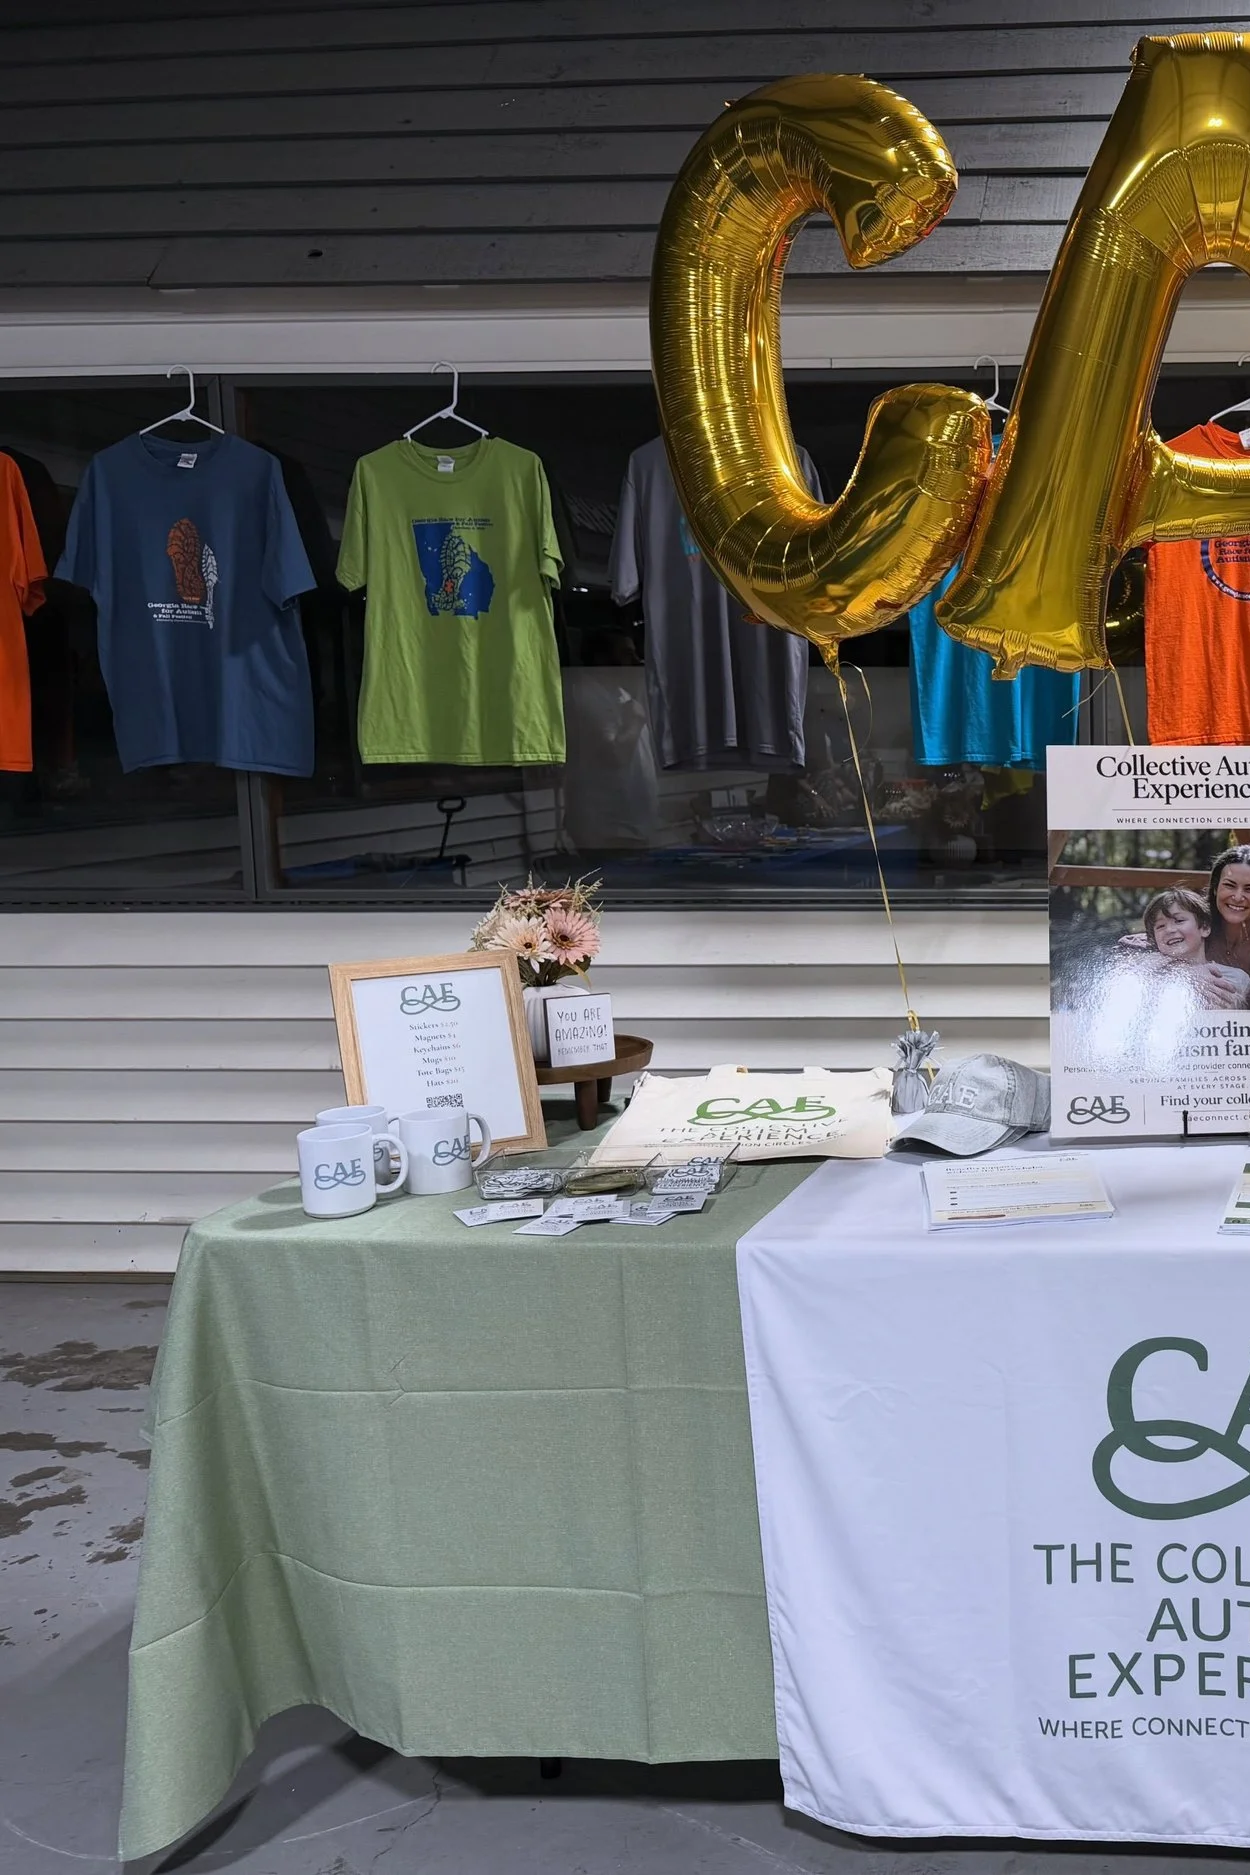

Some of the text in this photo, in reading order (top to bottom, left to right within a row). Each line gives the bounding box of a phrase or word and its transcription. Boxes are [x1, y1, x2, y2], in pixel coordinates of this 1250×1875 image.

[1096, 754, 1211, 778] Collective
[401, 982, 454, 1006] CAE
[557, 1007, 601, 1022] YOU ARE
[409, 1022, 439, 1031] Stickers
[415, 1034, 446, 1042] Magnets
[414, 1044, 451, 1055] Keychains
[422, 1057, 443, 1065] Mugs
[1192, 1062, 1225, 1071] provider
[417, 1069, 433, 1077] Tote
[435, 1066, 453, 1075] Bags
[426, 1080, 444, 1088] Hats
[928, 1083, 978, 1108] CAE
[1160, 1094, 1190, 1106] Find
[1193, 1096, 1223, 1108] your
[694, 1095, 827, 1120] CAE
[1070, 1095, 1126, 1116] CAE
[314, 1158, 362, 1181] CAE
[1033, 1543, 1134, 1584] THE
[1038, 1716, 1123, 1740] WHERE
